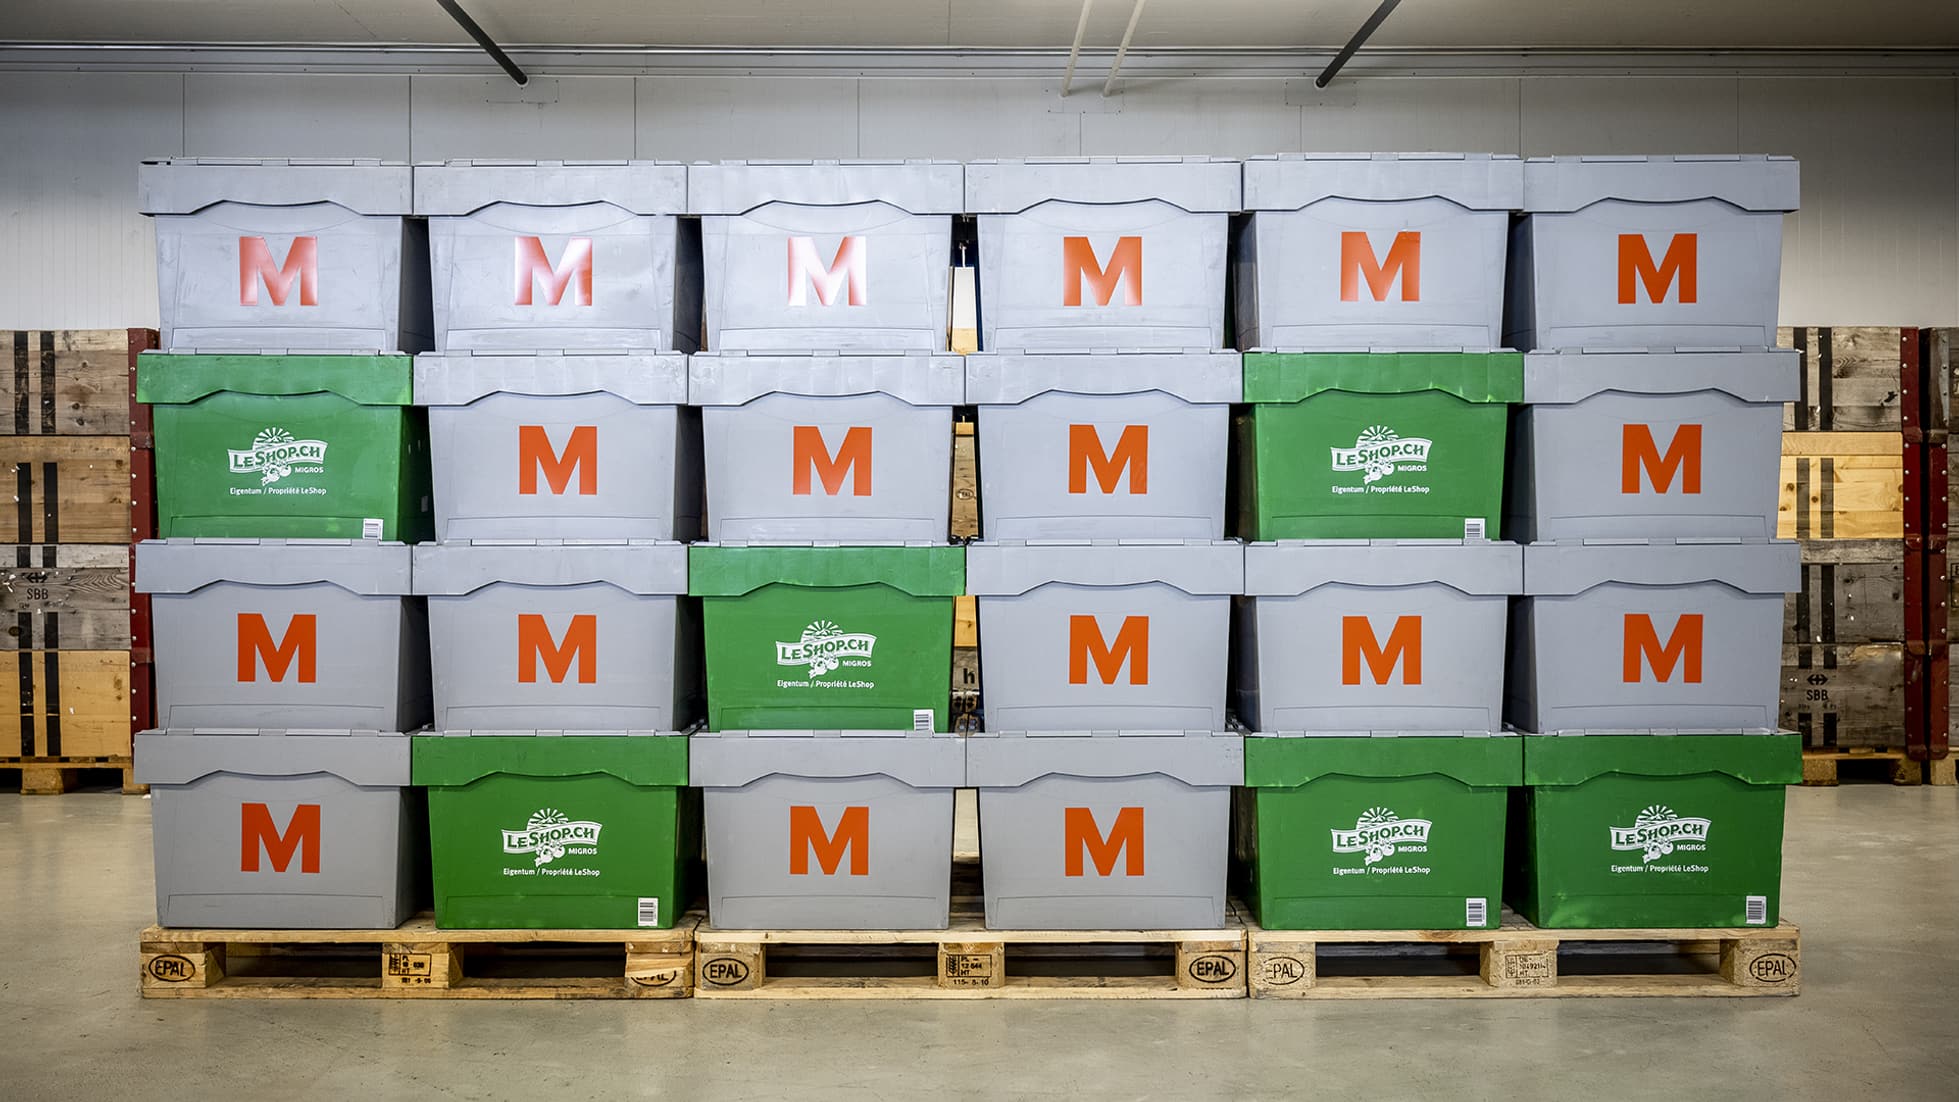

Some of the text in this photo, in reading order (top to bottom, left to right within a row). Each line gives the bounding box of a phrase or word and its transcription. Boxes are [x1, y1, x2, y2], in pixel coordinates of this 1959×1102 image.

[240, 237, 317, 306] M
[515, 237, 593, 306] M
[787, 237, 867, 306] M
[1064, 237, 1142, 306] M
[1341, 232, 1421, 302] M
[1618, 234, 1697, 304] M
[230, 487, 262, 495] Eigentum
[268, 487, 300, 495] Propriété
[301, 487, 327, 495] LeShop
[519, 426, 598, 495] M
[793, 426, 872, 496] M
[1068, 425, 1148, 495] M
[1332, 486, 1364, 494] Eigentum
[1370, 485, 1402, 494] Propriété
[1403, 485, 1430, 494] LeShop
[1622, 424, 1702, 494] M
[27, 588, 49, 600] SBB
[238, 613, 317, 683] M
[518, 614, 597, 684] M
[1069, 615, 1149, 685] M
[1342, 616, 1422, 685] M
[1623, 614, 1703, 684] M
[777, 680, 809, 688] Eigentum
[815, 680, 847, 688] Propriété
[848, 680, 875, 688] LeShop
[1806, 689, 1828, 701] SBB
[241, 803, 320, 873] M
[503, 868, 535, 876] Eigentum
[541, 868, 573, 876] Propriété
[574, 868, 600, 876] LeShop
[790, 806, 869, 876] M
[1065, 807, 1144, 877] M
[1333, 867, 1365, 875] Eigentum
[1371, 866, 1403, 875] Propriété
[1404, 866, 1430, 875] LeShop
[1611, 865, 1644, 873] Eigentum
[1649, 864, 1681, 873] Propriété
[1683, 864, 1709, 873] LeShop
[155, 960, 187, 976] EPAL
[709, 964, 743, 979] EPAL
[1196, 961, 1230, 976] EPAL
[1757, 960, 1787, 976] EPAL
